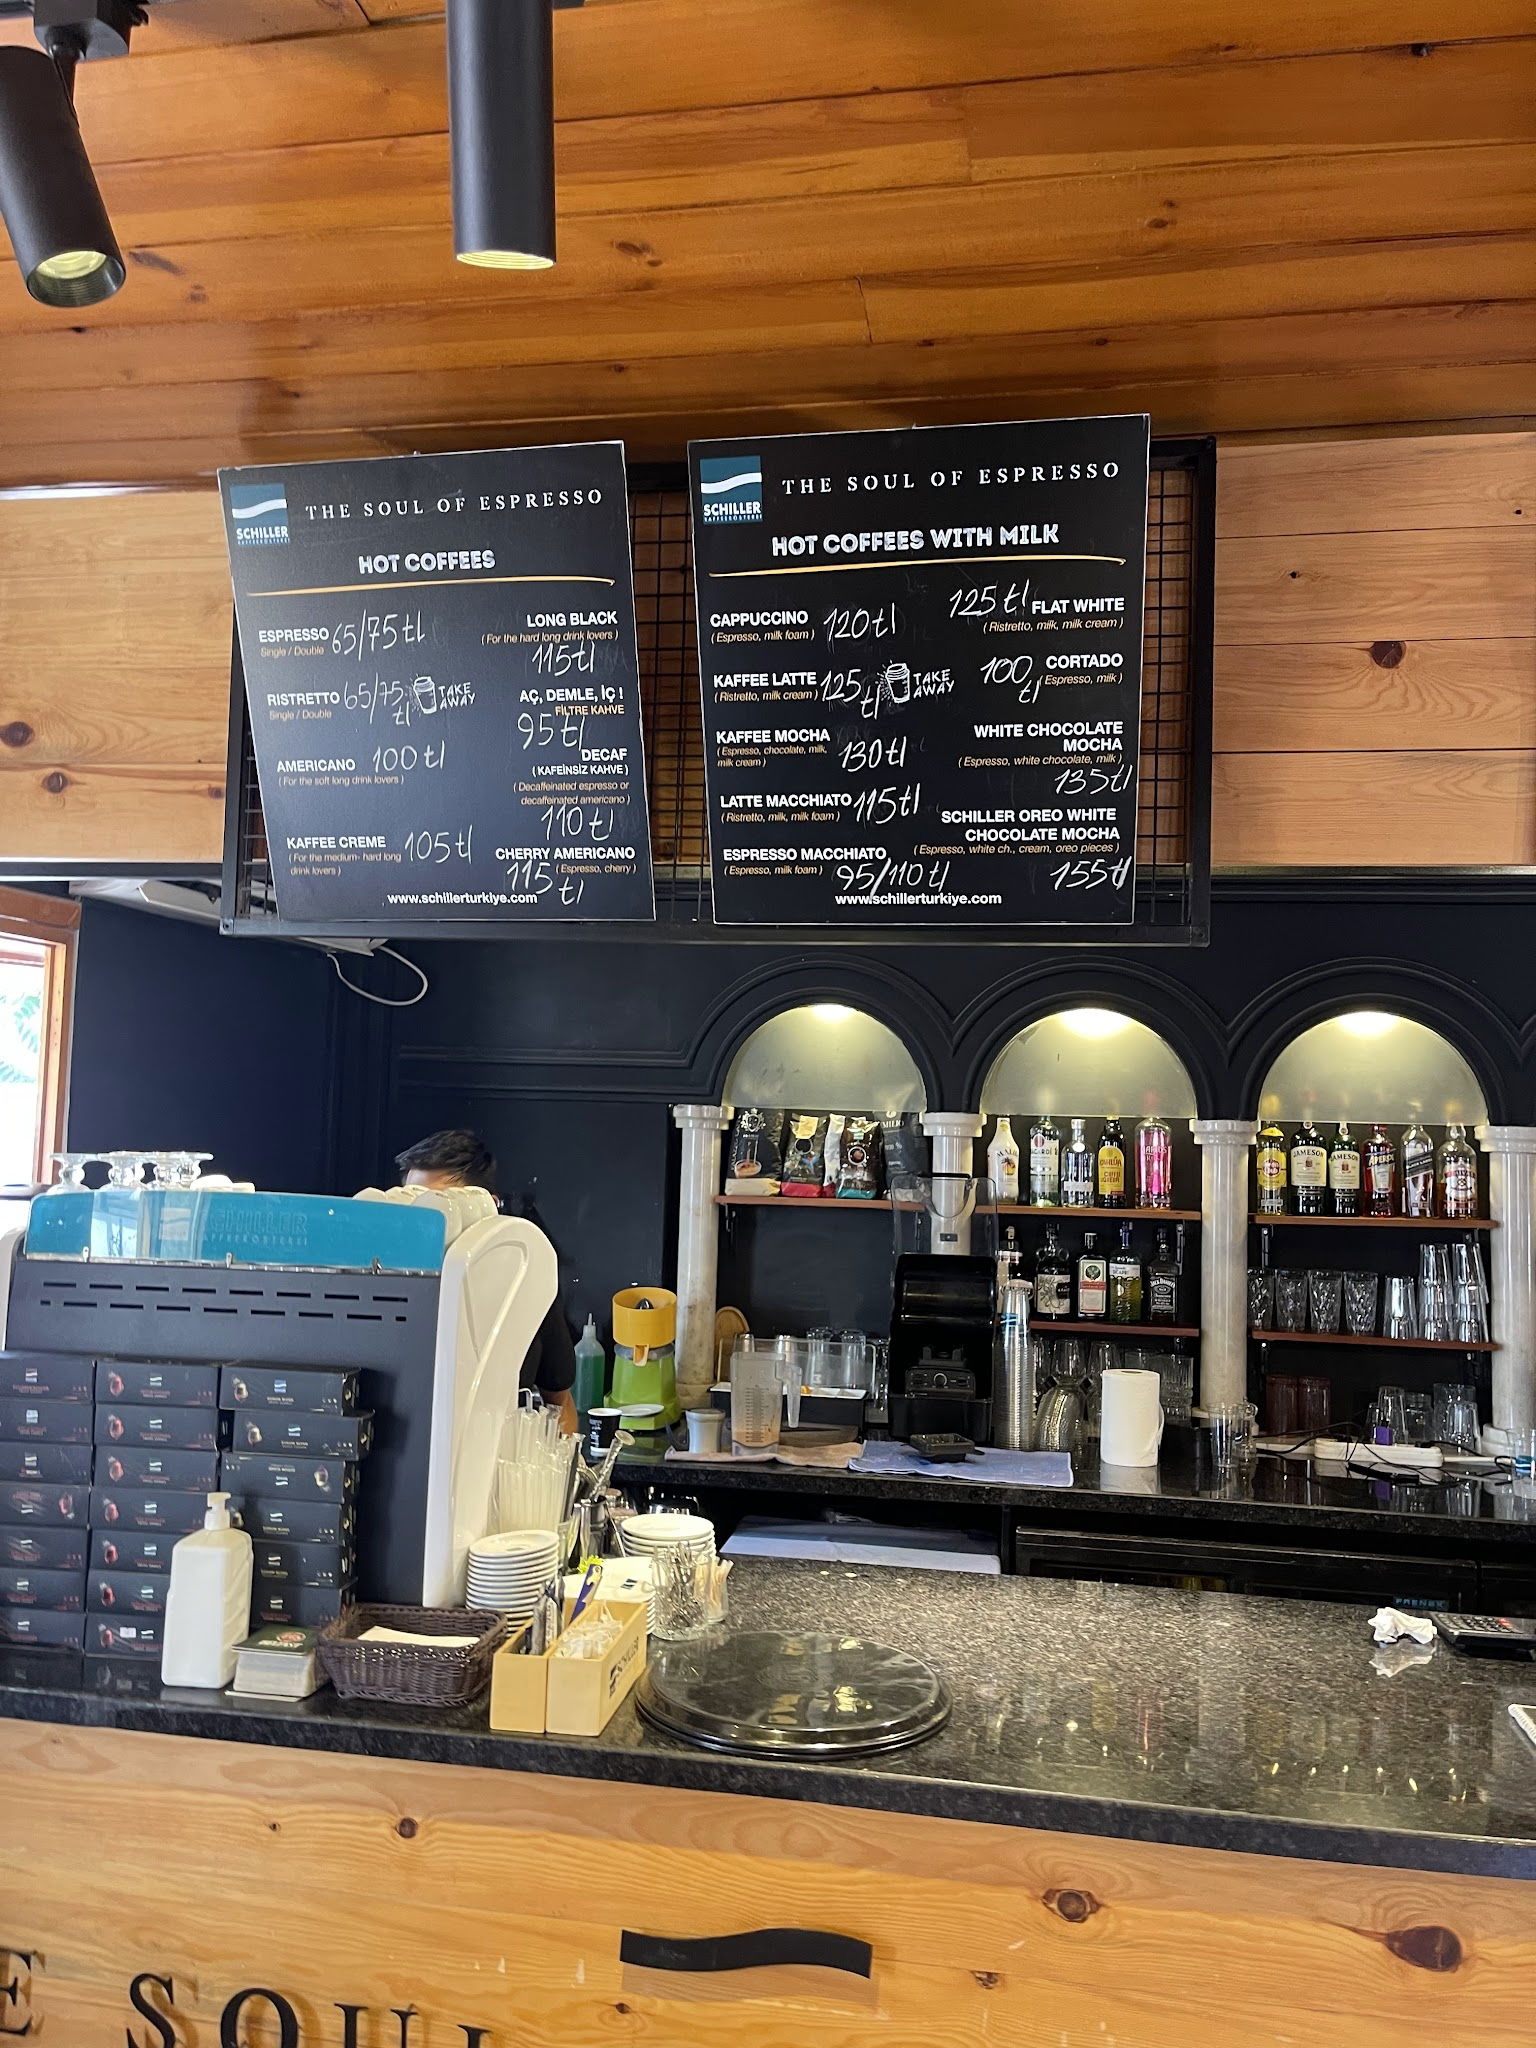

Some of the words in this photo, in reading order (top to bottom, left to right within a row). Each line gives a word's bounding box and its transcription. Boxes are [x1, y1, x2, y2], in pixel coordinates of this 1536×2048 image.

[782, 477, 832, 494] THE
[847, 473, 915, 492] SOUL
[930, 470, 963, 487] OF
[979, 462, 1119, 485] ESPRESSO
[305, 503, 350, 520] THE
[364, 499, 423, 517] SOUL
[437, 497, 465, 512] OF
[480, 489, 601, 511] ESPRESSO
[704, 501, 761, 517] SCHILLER
[237, 526, 288, 540] SCHILLER
[772, 535, 818, 556] HOT
[823, 530, 925, 554] COFFEES
[930, 526, 993, 549] WITH
[1000, 523, 1060, 545] MILK
[359, 554, 400, 574] HOT
[405, 549, 496, 572] COFFEES
[1031, 599, 1070, 614] FLAT
[1073, 597, 1125, 613] WHITE
[526, 613, 566, 628] LONG
[570, 611, 617, 626] BLACK
[710, 610, 808, 627] CAPPUCCINO
[1037, 620, 1059, 632] milk,
[1062, 619, 1083, 629] milk
[259, 628, 329, 642] ESPRESSO
[504, 633, 517, 643] the
[520, 632, 539, 642] hard
[542, 632, 560, 644] long
[563, 631, 584, 641] drink
[764, 630, 783, 641] milk
[260, 647, 286, 658] Single
[295, 645, 324, 656] Double
[1046, 653, 1123, 669] CORTADO
[913, 668, 950, 686] TAKE
[980, 655, 1033, 685] 100
[713, 673, 769, 688] KAFFEE
[772, 671, 817, 686] LATTE
[438, 682, 471, 697] TAKE
[546, 687, 598, 703] DEMLE,
[762, 690, 782, 701] milk
[913, 680, 955, 698] AWAY
[267, 691, 340, 706] RISTRETTO
[440, 693, 475, 710] AWAY
[270, 710, 295, 721] Single
[303, 709, 331, 720] Double
[591, 704, 624, 715] KAHVE
[716, 729, 771, 744] KAFFEE
[775, 728, 830, 742] MOCHA
[974, 723, 1024, 738] WHITE
[1026, 721, 1123, 737] CHOCOLATE
[764, 744, 806, 756] chocolate,
[809, 744, 827, 755] milk,
[1063, 738, 1122, 752] MOCHA
[581, 748, 627, 761] DECAF
[1014, 755, 1040, 766] white
[1042, 754, 1092, 765] chocolate,
[277, 759, 356, 773] AMERICANO
[717, 758, 734, 767] milk
[299, 776, 312, 785] the
[314, 775, 330, 785] soft
[332, 775, 350, 787] long
[352, 775, 373, 785] drink
[579, 782, 617, 792] espresso
[620, 782, 629, 790] or
[720, 795, 763, 808] LATTE
[766, 793, 851, 808] MACCHIATO
[768, 812, 788, 823] milk,
[791, 812, 809, 821] milk
[941, 809, 1015, 824] SCHILLER
[1019, 808, 1064, 823] OREO
[1067, 808, 1116, 822] WHITE
[965, 828, 1057, 842] CHOCOLATE
[1061, 827, 1120, 841] MOCHA
[286, 836, 336, 849] KAFFEE
[338, 836, 386, 848] CREME
[969, 844, 995, 854] white
[1018, 845, 1051, 855] cream,
[1055, 844, 1079, 854] oreo
[309, 853, 323, 862] the
[363, 852, 382, 862] hard
[384, 852, 401, 864] long
[495, 847, 549, 860] CHERRY
[554, 846, 635, 860] AMERICANO
[723, 848, 797, 861] ESPRESSO
[800, 847, 887, 861] MACCHIATO
[290, 866, 310, 876] drink
[774, 864, 793, 874] milk
[387, 891, 537, 906] www.schillerturkiye.com
[835, 892, 1002, 907] www.schillerturkiye.com
